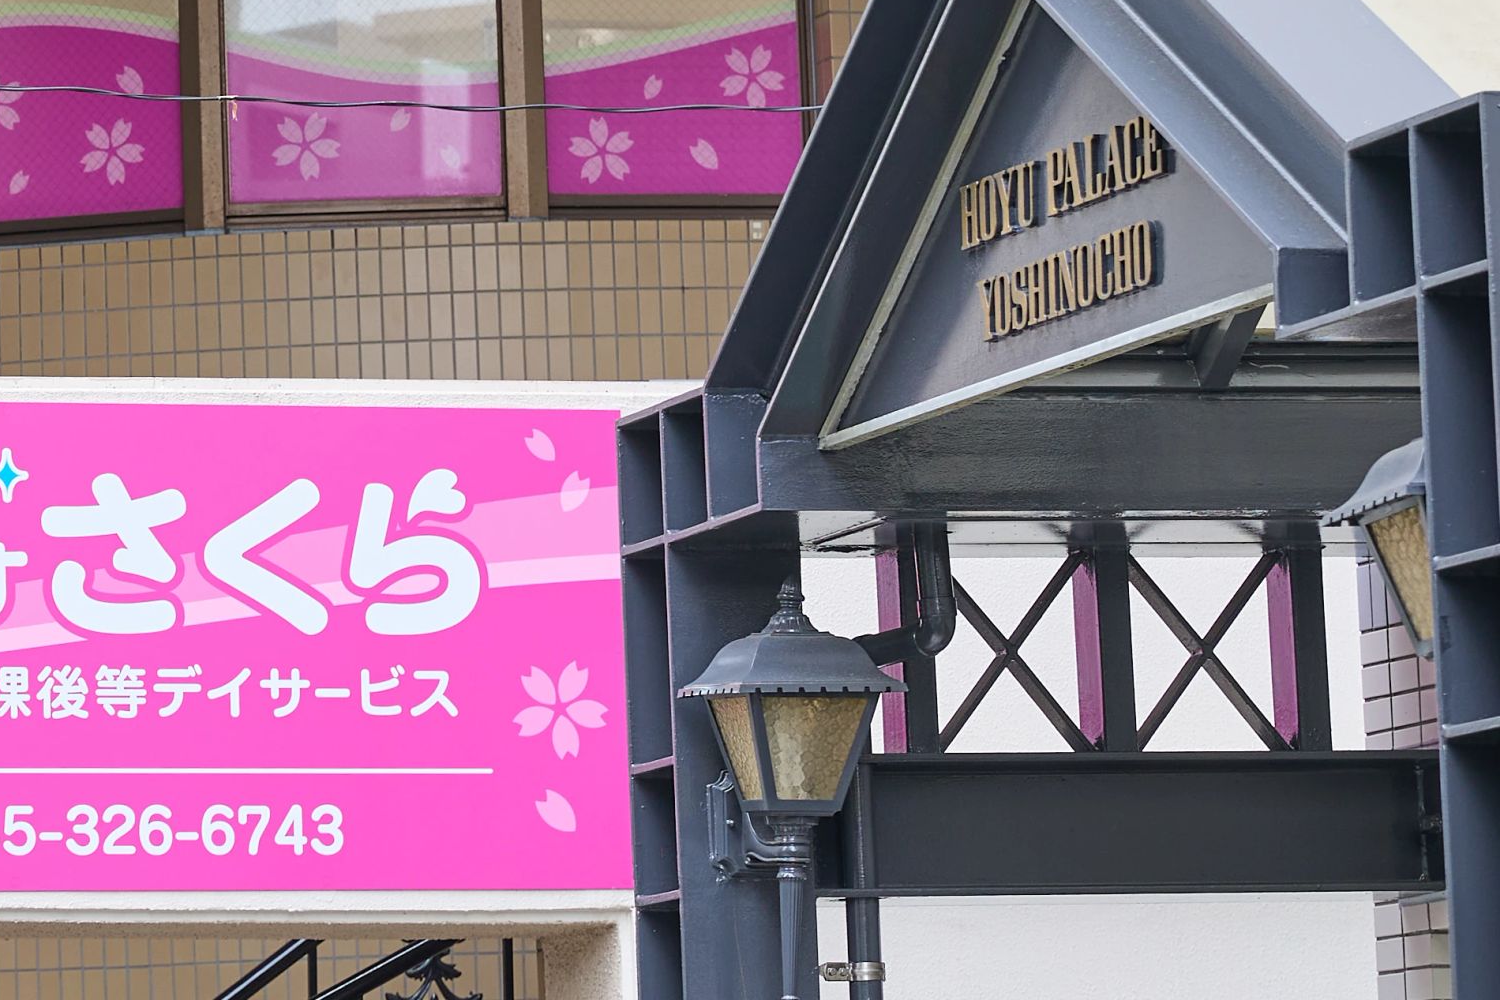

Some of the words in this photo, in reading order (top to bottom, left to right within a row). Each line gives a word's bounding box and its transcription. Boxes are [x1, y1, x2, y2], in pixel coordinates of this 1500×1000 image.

[959, 162, 1037, 250] HOYU
[1046, 116, 1163, 216] PALACE
[977, 219, 1153, 342] YOSHINOCHO
